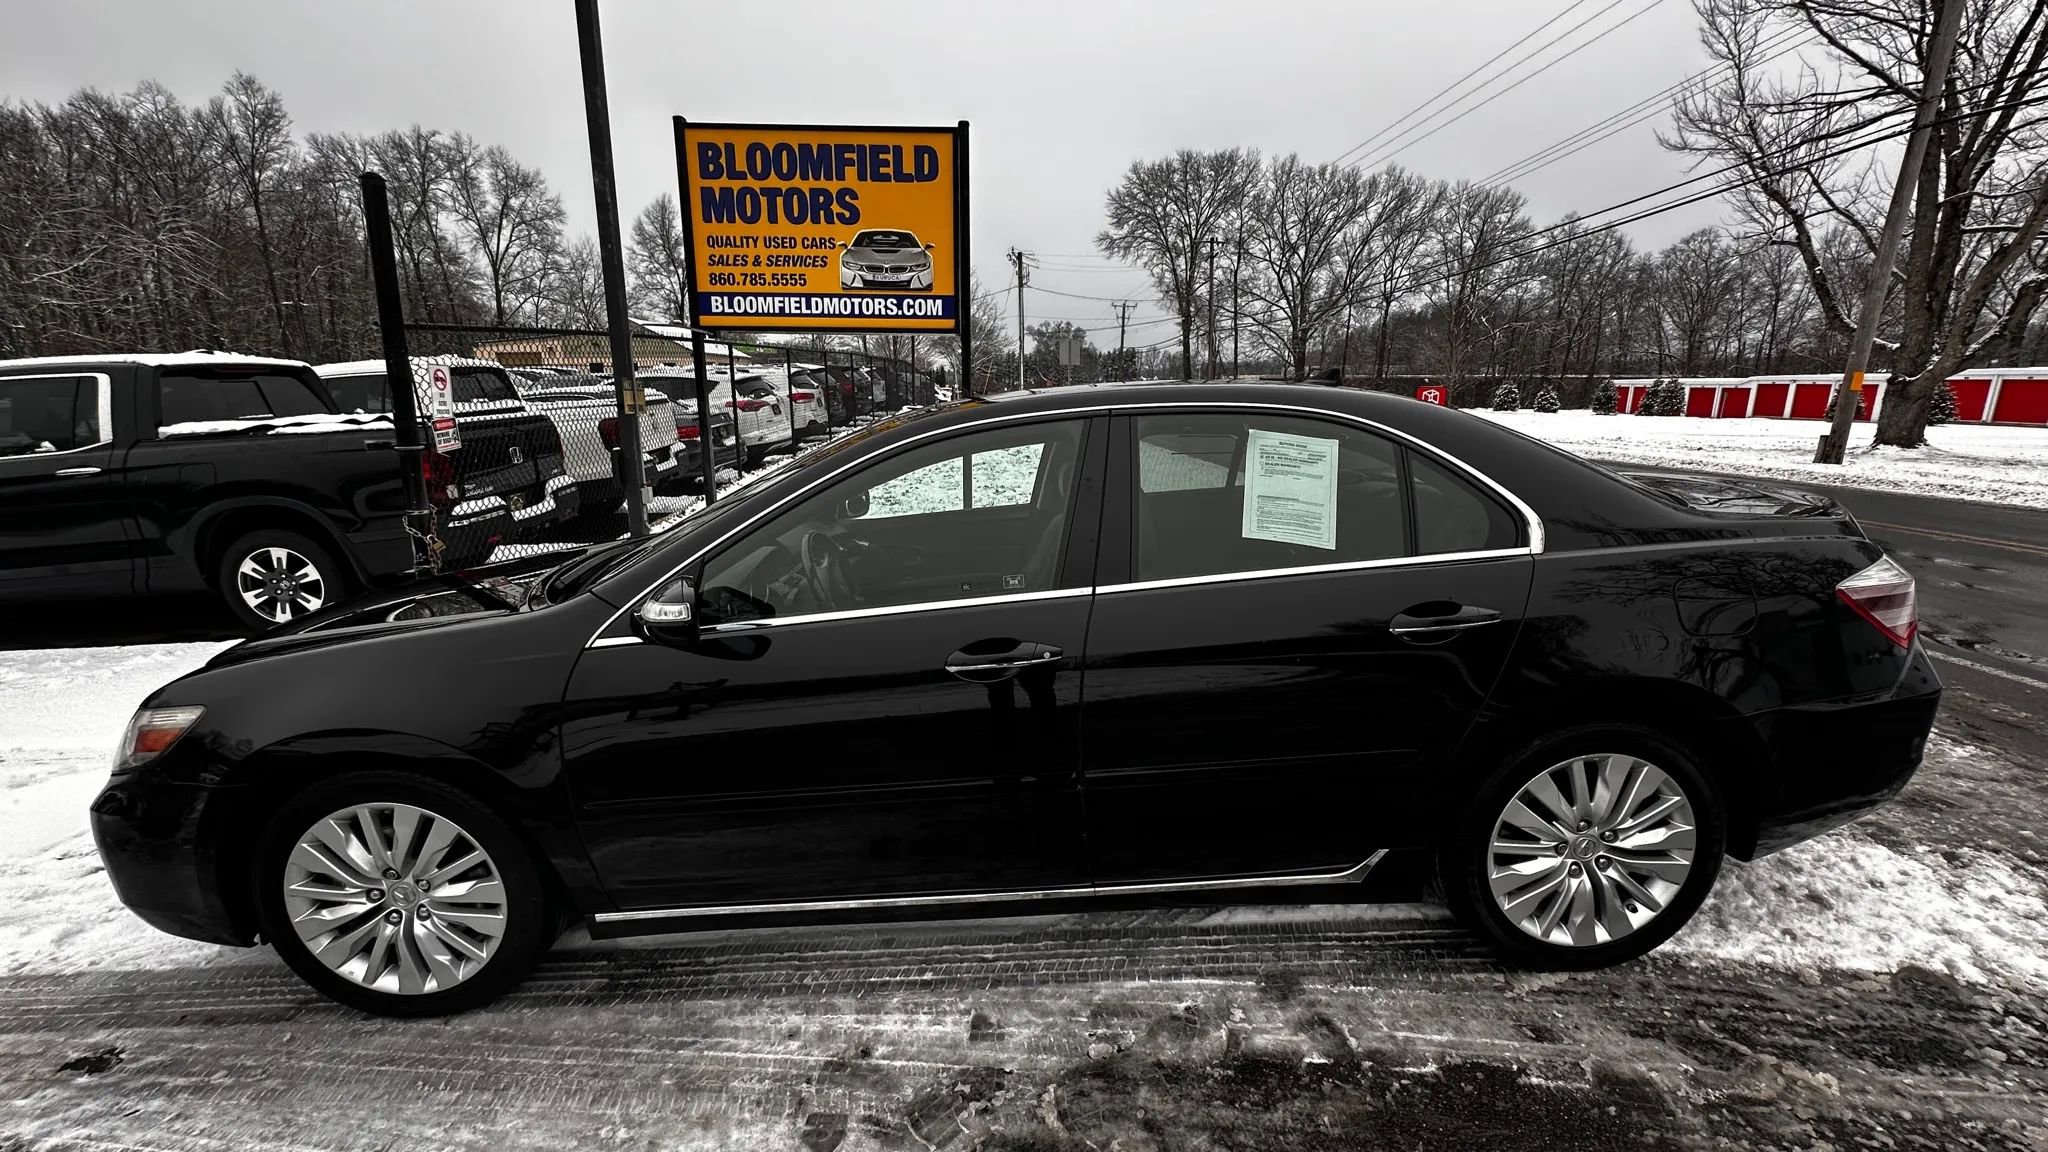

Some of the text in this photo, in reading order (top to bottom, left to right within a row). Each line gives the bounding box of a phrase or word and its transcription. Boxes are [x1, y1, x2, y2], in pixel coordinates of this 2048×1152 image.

[697, 142, 939, 183] BLOOMFIELD
[700, 187, 861, 225] MOTORS
[706, 235, 837, 250] QUALITY USED CARS
[708, 254, 829, 269] SALES & SERVICES
[709, 273, 807, 287] 860.785.5555
[710, 296, 943, 316] BLOOMFIELDMOTORS.COM
